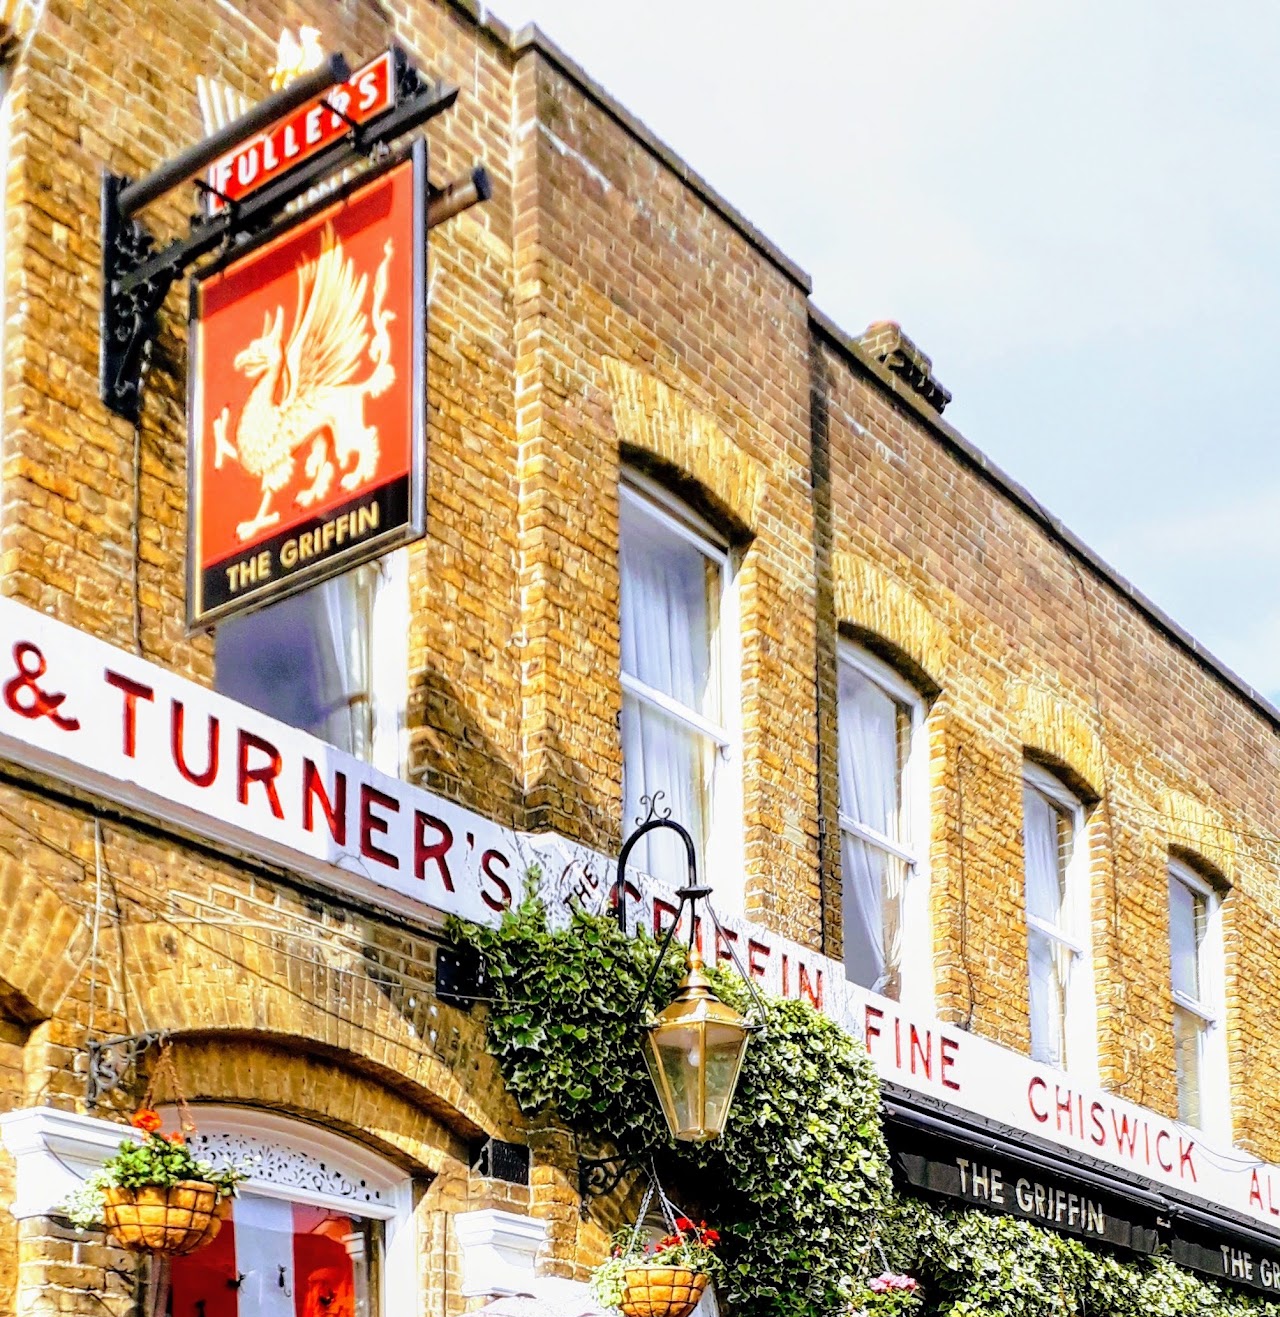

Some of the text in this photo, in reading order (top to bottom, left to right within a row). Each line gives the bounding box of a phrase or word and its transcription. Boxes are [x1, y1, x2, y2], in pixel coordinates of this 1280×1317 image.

[226, 500, 380, 594] THE GRIFFIN
[3, 640, 514, 912] & TURNER'S
[865, 1004, 960, 1091] FINE
[1027, 1076, 1198, 1183] CHISWICK
[956, 1157, 1105, 1235] THE GRIFFIN
[1220, 1245, 1253, 1280] THE
